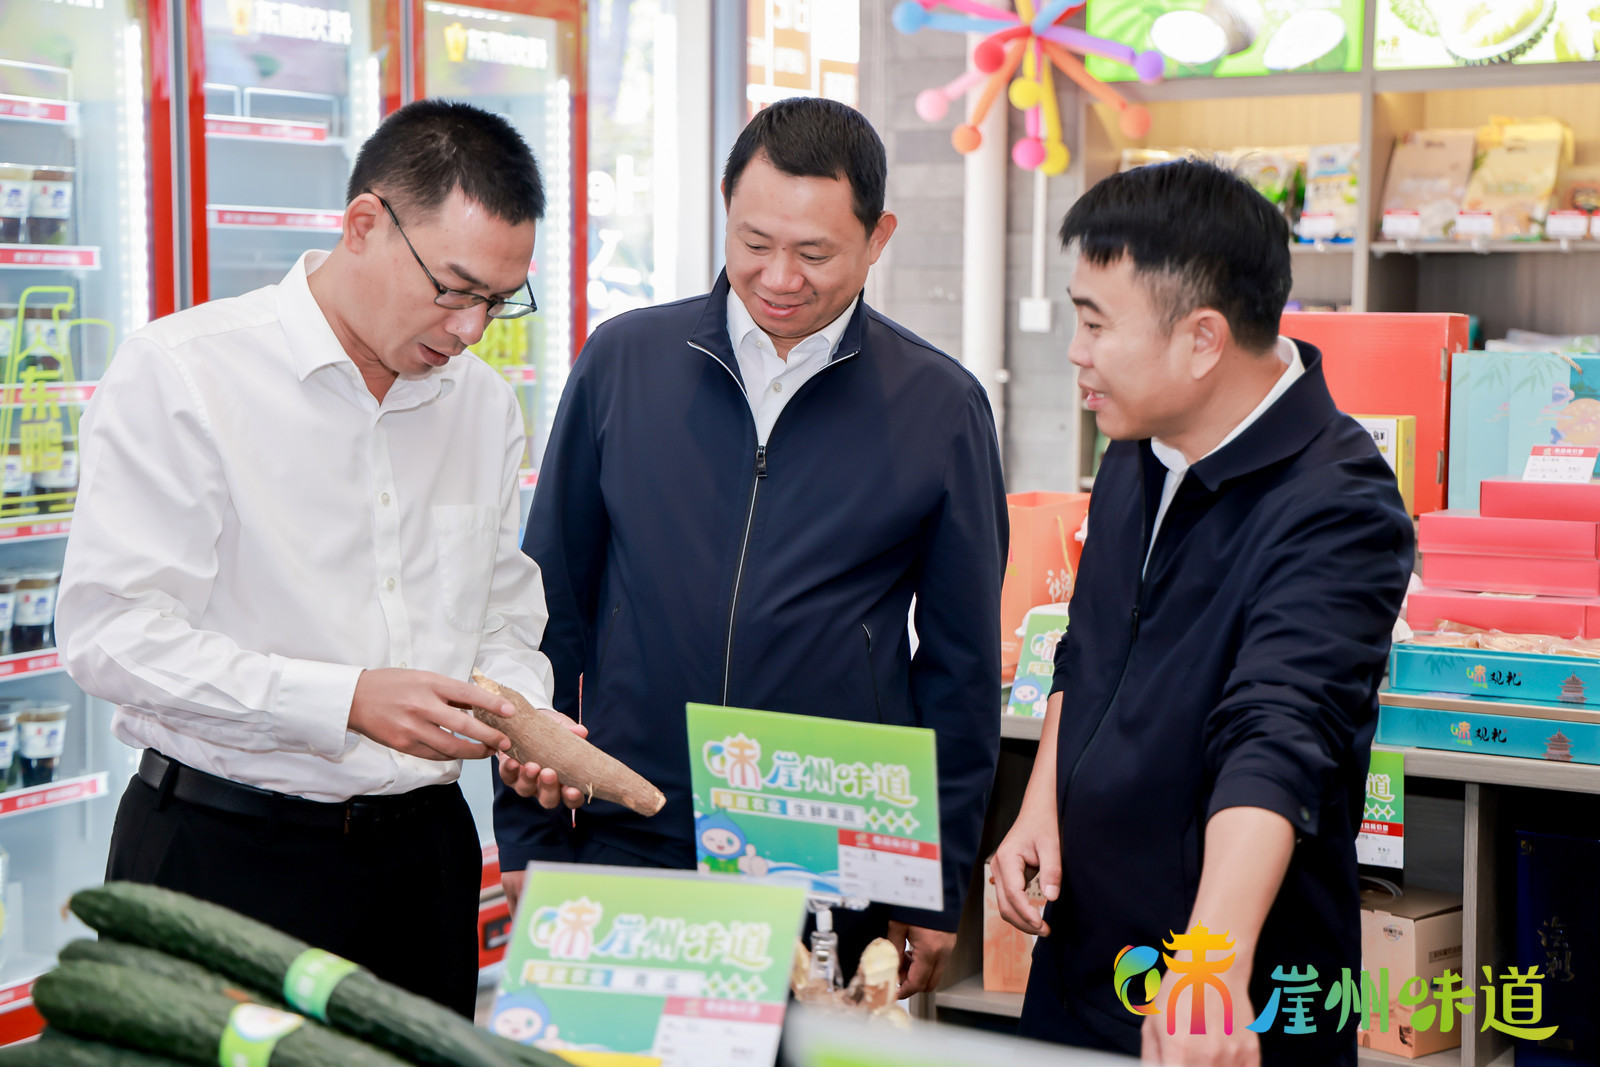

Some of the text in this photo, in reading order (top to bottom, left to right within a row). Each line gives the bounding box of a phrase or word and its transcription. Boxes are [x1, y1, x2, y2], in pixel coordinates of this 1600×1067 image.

[764, 751, 918, 807] 崖州味道
[595, 913, 773, 972] 崖州味道
